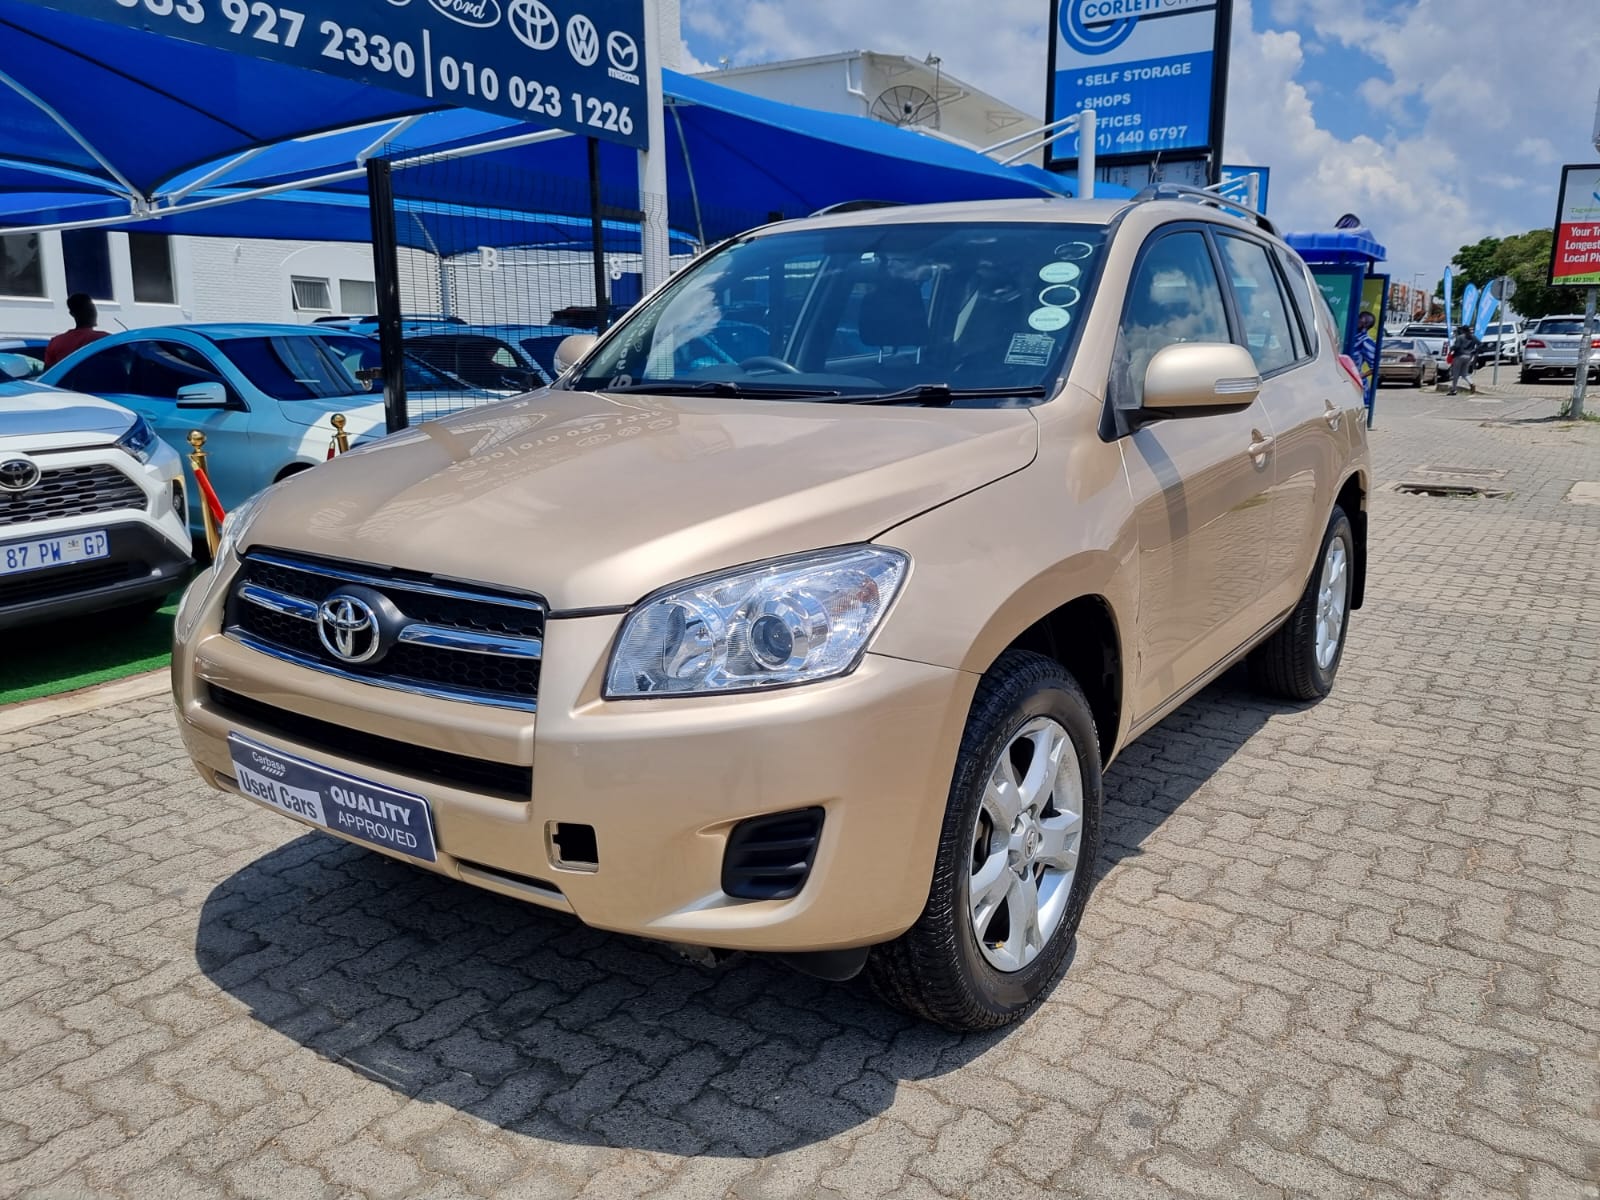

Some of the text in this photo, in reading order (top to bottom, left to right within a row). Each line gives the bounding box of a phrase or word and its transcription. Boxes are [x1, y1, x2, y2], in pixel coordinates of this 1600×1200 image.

[221, 0, 306, 48] 927
[319, 21, 415, 78] 2330
[440, 56, 499, 101] 010
[509, 75, 562, 118] 023
[571, 93, 634, 136] 1226
[1085, 62, 1192, 87] SELF STORAGE
[1083, 93, 1131, 110] SHOPS
[1095, 113, 1142, 129] FFICES
[1116, 130, 1144, 146] 440
[1149, 125, 1188, 142] 6797
[1571, 226, 1592, 237] Your
[1563, 252, 1588, 263] Local
[6, 534, 105, 569] 87 PW GP
[252, 751, 286, 772] Carbase
[239, 769, 318, 819] Used Cars
[330, 785, 411, 826] QUALITY
[338, 810, 417, 849] APPROVED
